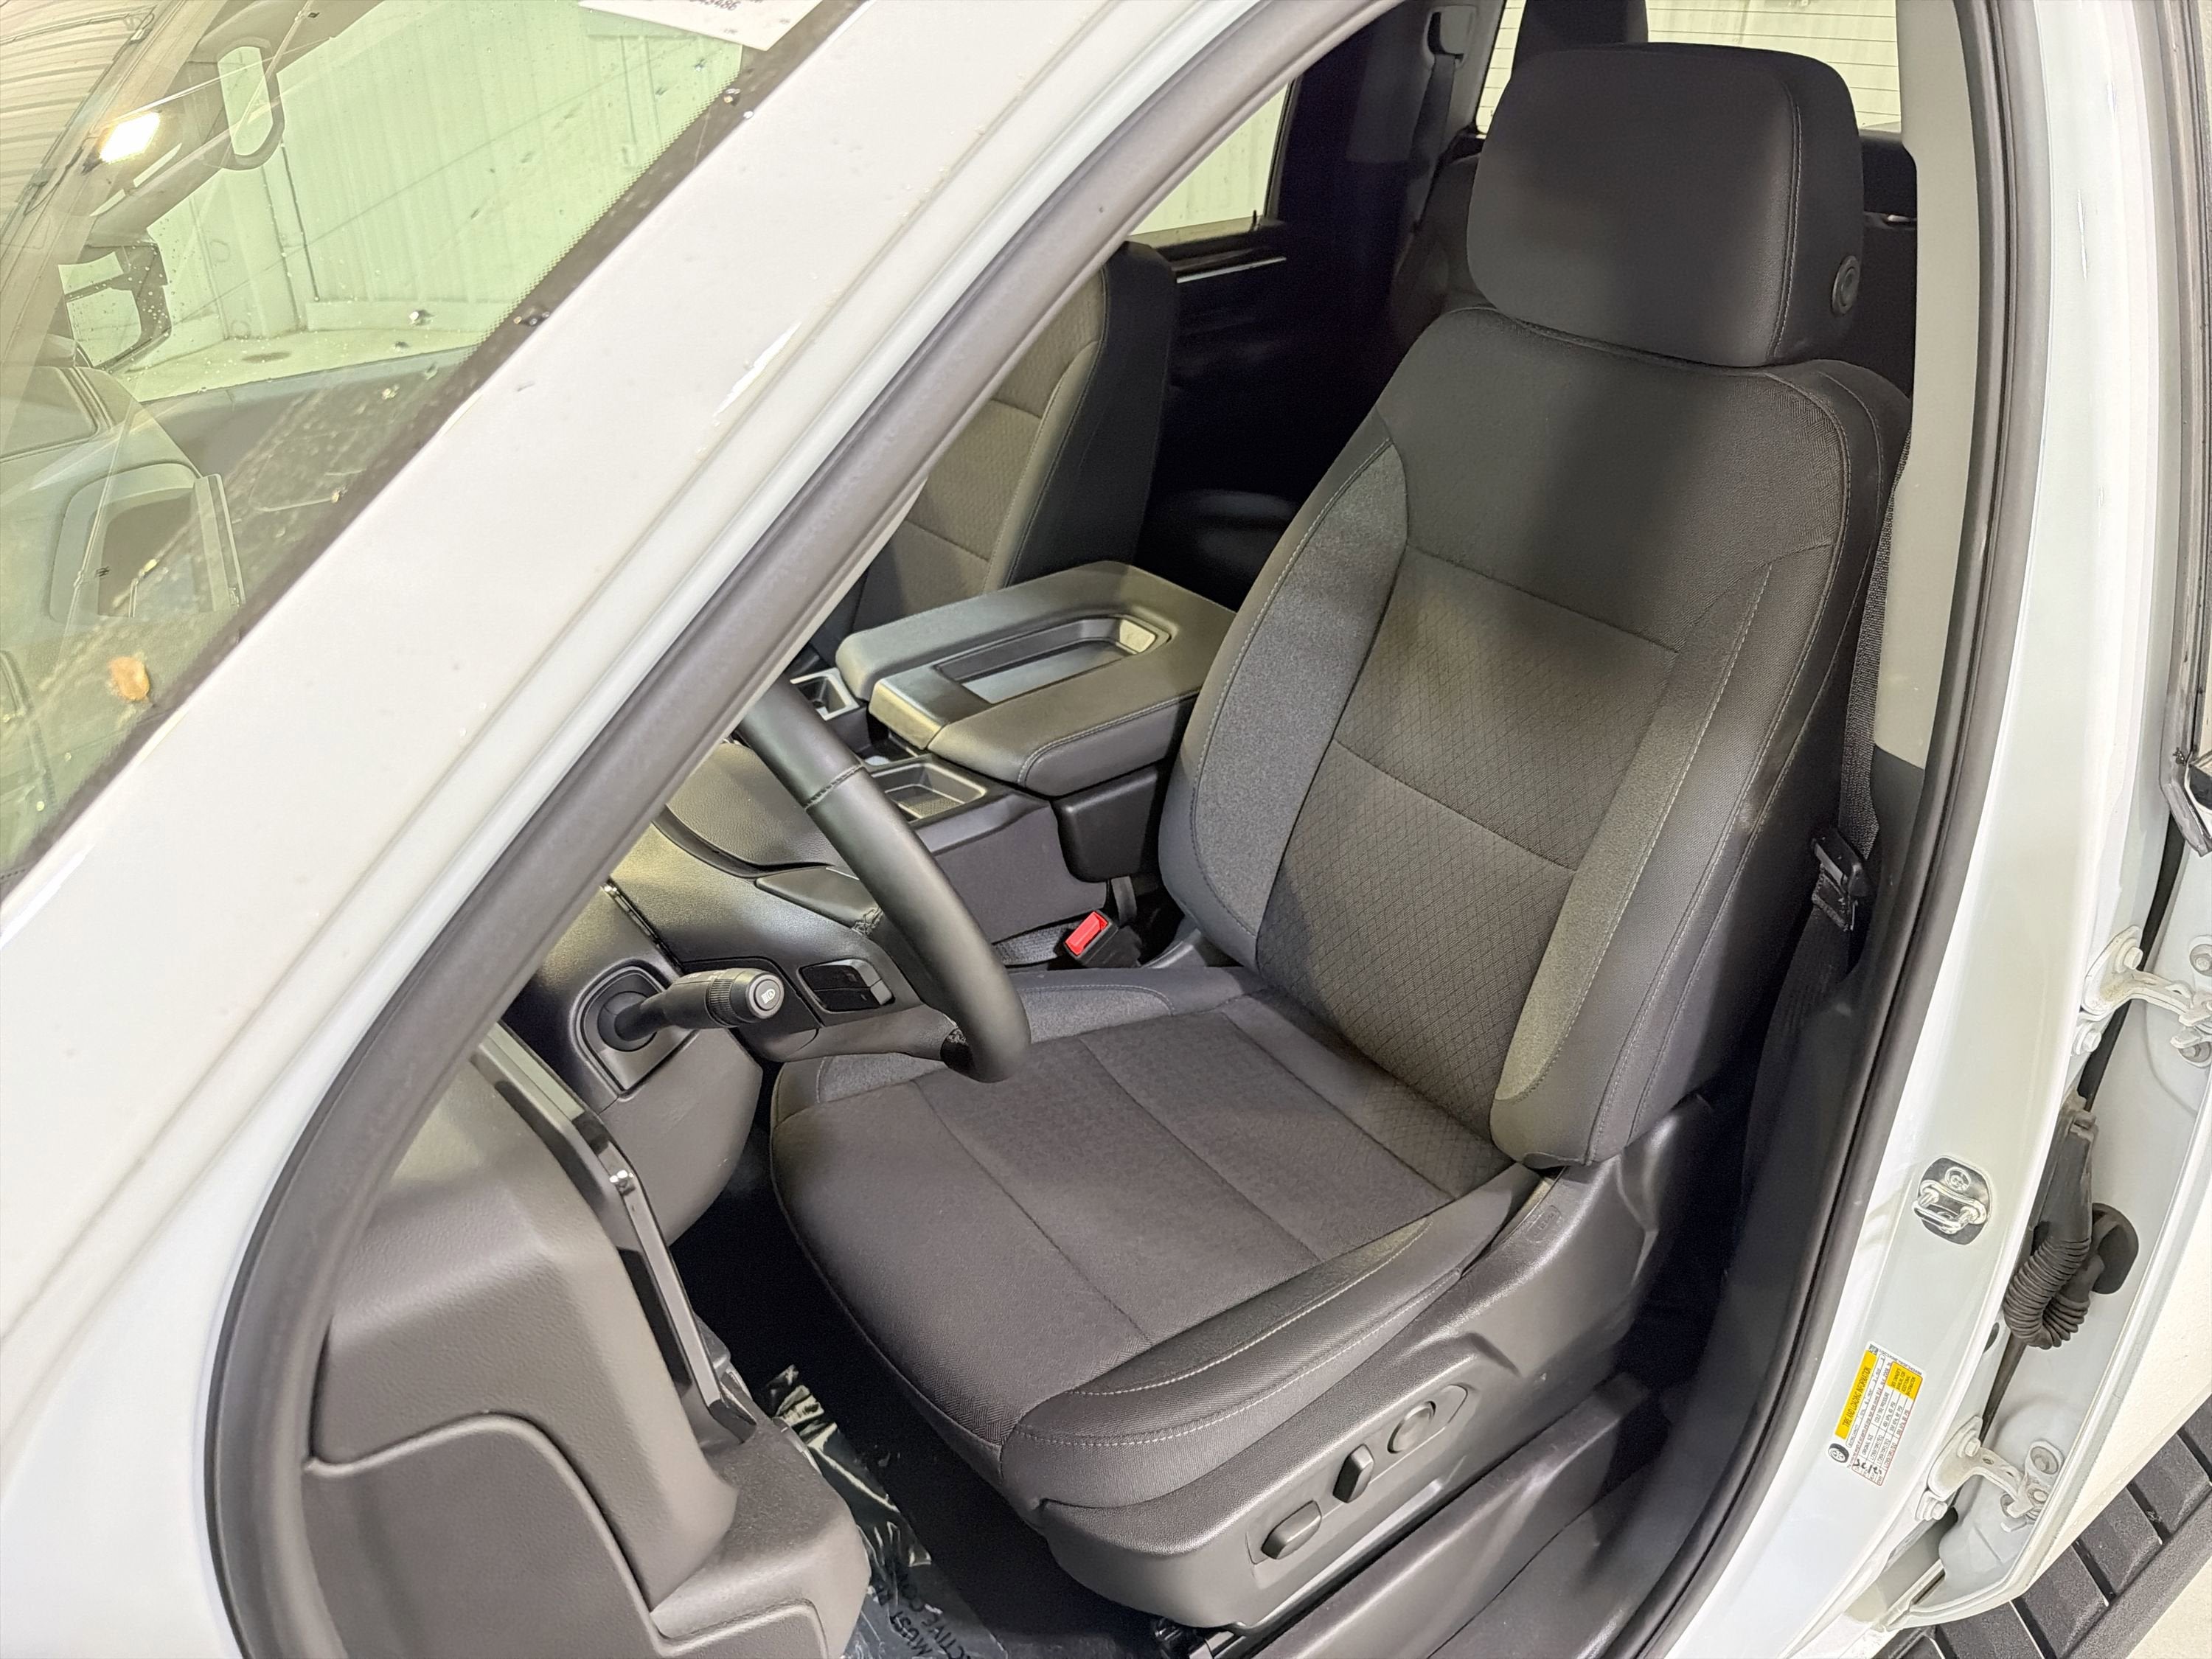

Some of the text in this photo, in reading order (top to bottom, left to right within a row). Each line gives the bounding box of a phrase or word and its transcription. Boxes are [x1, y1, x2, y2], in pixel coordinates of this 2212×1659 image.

[1855, 1365, 1871, 1394] INFORMATION
[1848, 1389, 1862, 1411] LOADING
[1842, 1416, 1851, 1427] TIRE
[1845, 1408, 1855, 1419] AND
[889, 1611, 933, 1656] MUST
